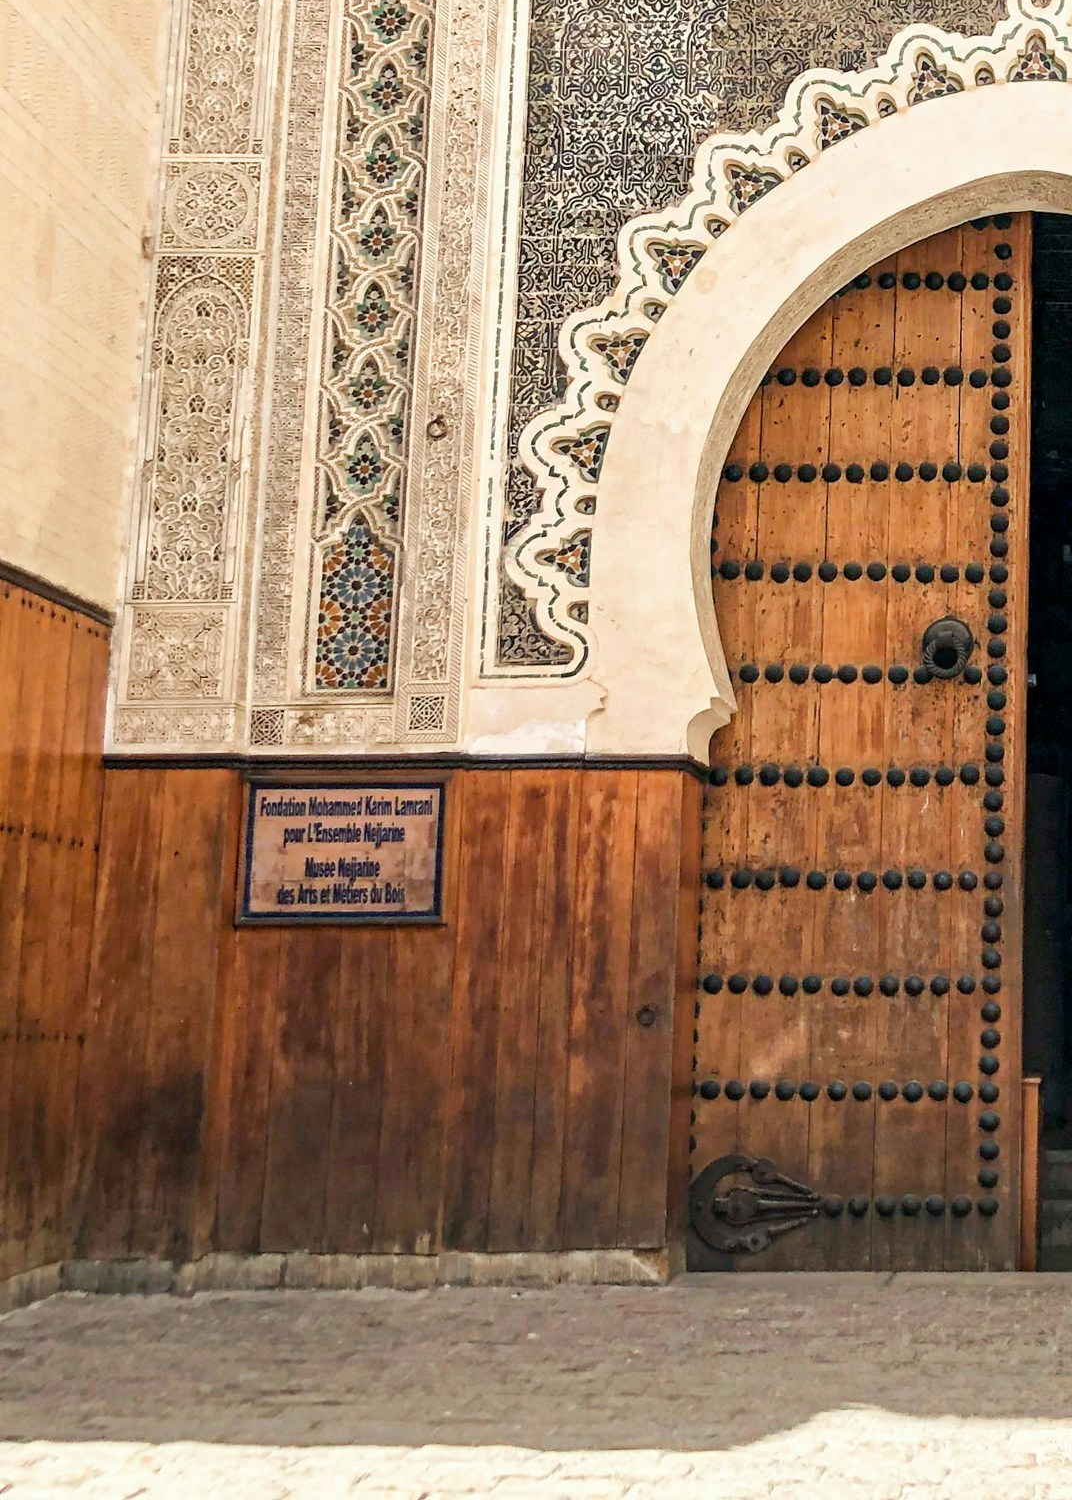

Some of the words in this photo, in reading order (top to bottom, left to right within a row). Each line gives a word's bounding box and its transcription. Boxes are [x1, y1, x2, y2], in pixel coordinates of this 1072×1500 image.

[260, 796, 306, 816] Fondation
[309, 796, 363, 816] Mohammed
[365, 795, 392, 816] Karim
[395, 795, 433, 816] Lamrani
[283, 827, 306, 848] pour
[363, 822, 405, 849] Nejjarine
[305, 857, 336, 878] Musée
[338, 857, 380, 884] Nejjarine
[277, 884, 295, 905] des
[297, 884, 317, 905] Arts
[320, 885, 331, 904] et
[333, 883, 369, 905] Métiers
[370, 884, 383, 904] du
[384, 882, 406, 905] Bois
